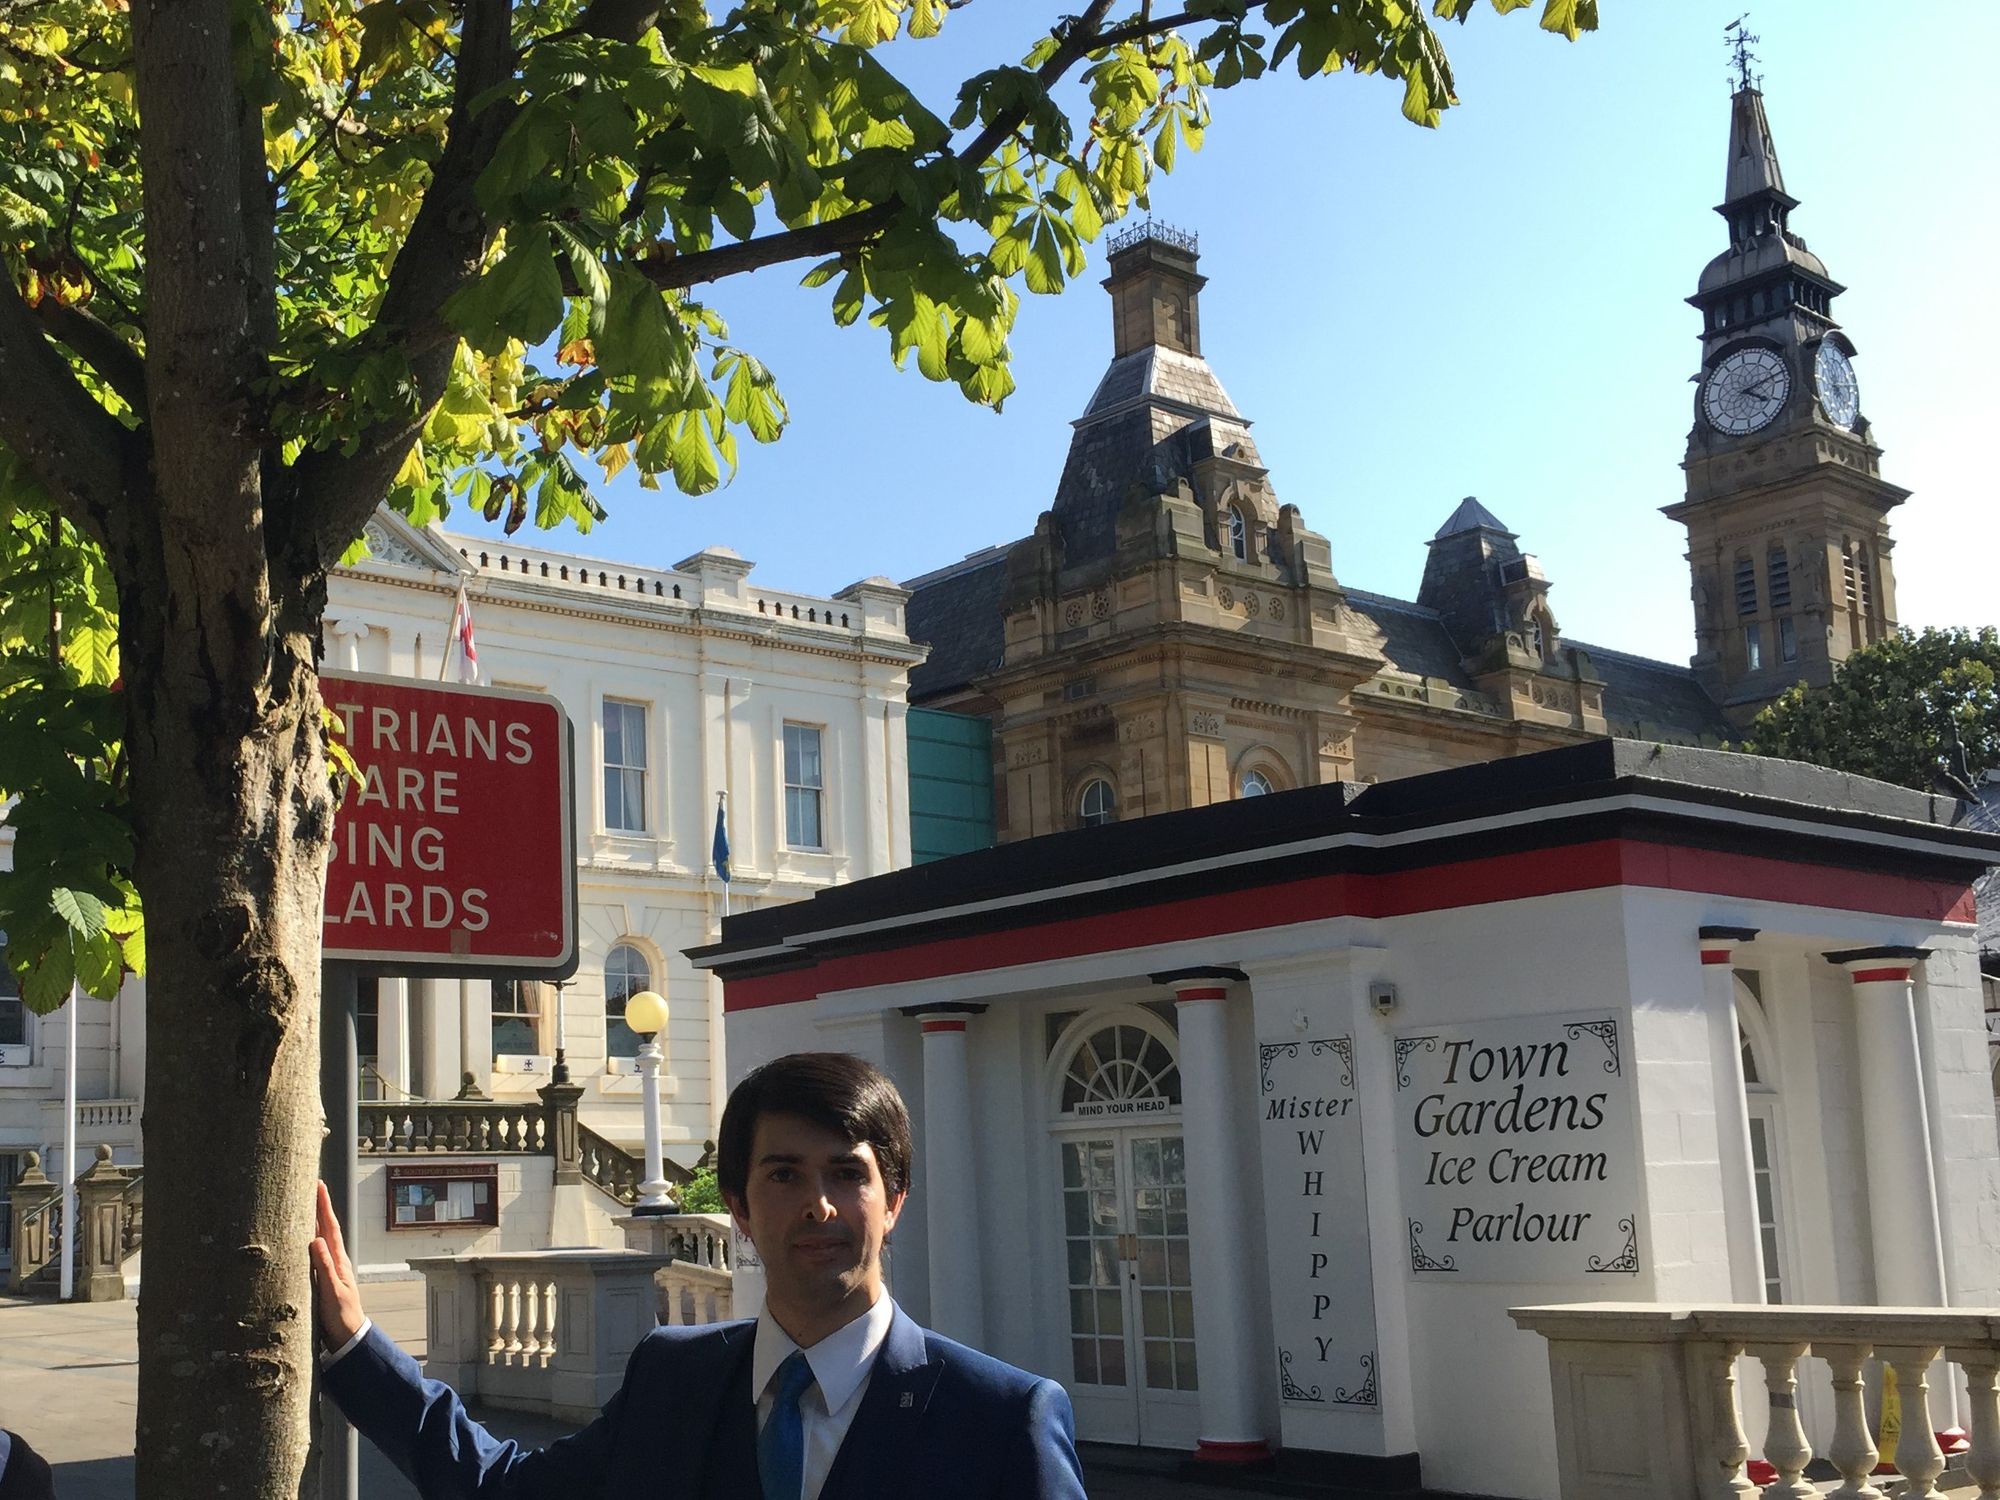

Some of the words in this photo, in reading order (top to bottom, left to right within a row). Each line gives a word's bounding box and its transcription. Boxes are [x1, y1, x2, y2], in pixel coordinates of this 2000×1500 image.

[335, 703, 533, 765] TRIANS
[1443, 1039, 1569, 1085] Town
[1078, 1105, 1103, 1116] MIND
[1106, 1103, 1134, 1114] YOUR
[1136, 1100, 1165, 1111] HEAD
[1265, 1096, 1354, 1121] Mister
[1414, 1084, 1608, 1138] Gardens
[1424, 1151, 1475, 1185] Ice
[1488, 1148, 1608, 1185] Cream
[1446, 1202, 1592, 1243] Parlour
[1297, 1130, 1333, 1363] WHIPPY
